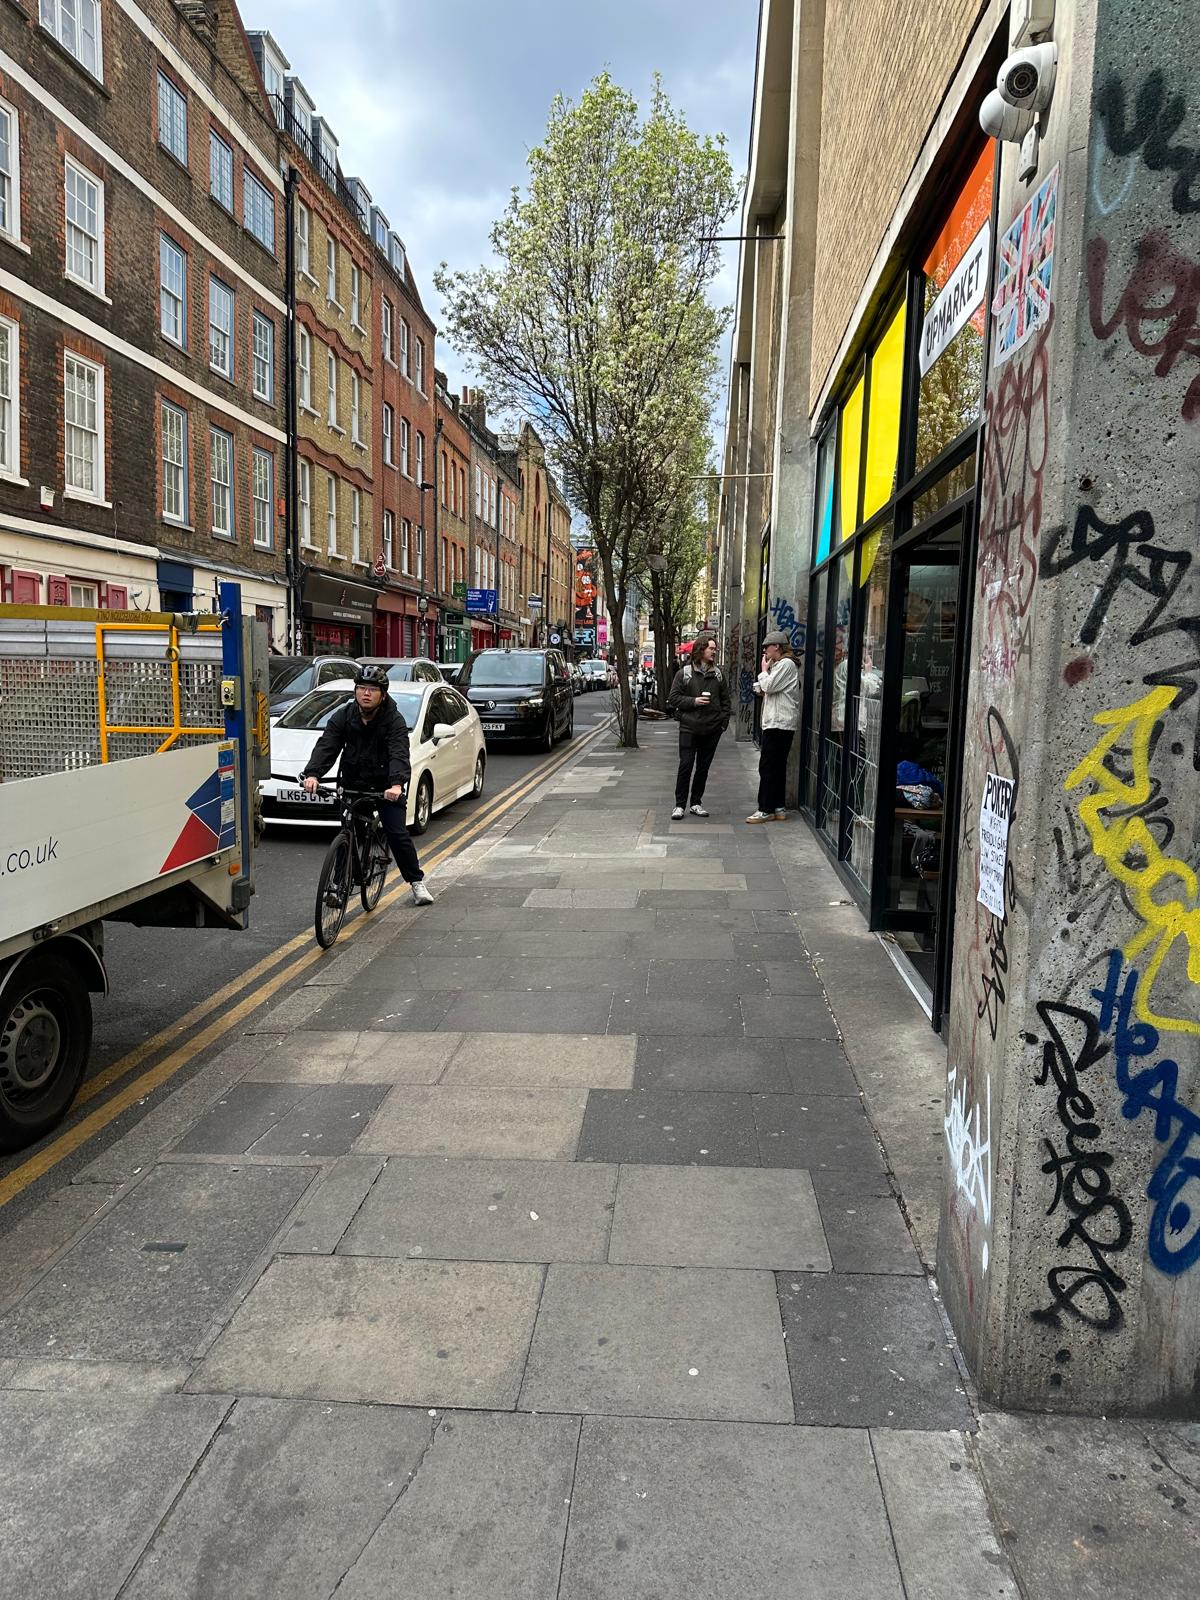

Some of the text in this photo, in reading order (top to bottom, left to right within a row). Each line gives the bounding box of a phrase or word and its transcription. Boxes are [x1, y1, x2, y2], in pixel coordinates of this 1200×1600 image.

[926, 248, 983, 357] UPMARKET
[280, 790, 307, 802] LK65
[983, 774, 1012, 820] POKER
[1, 836, 59, 876] .co.uk
